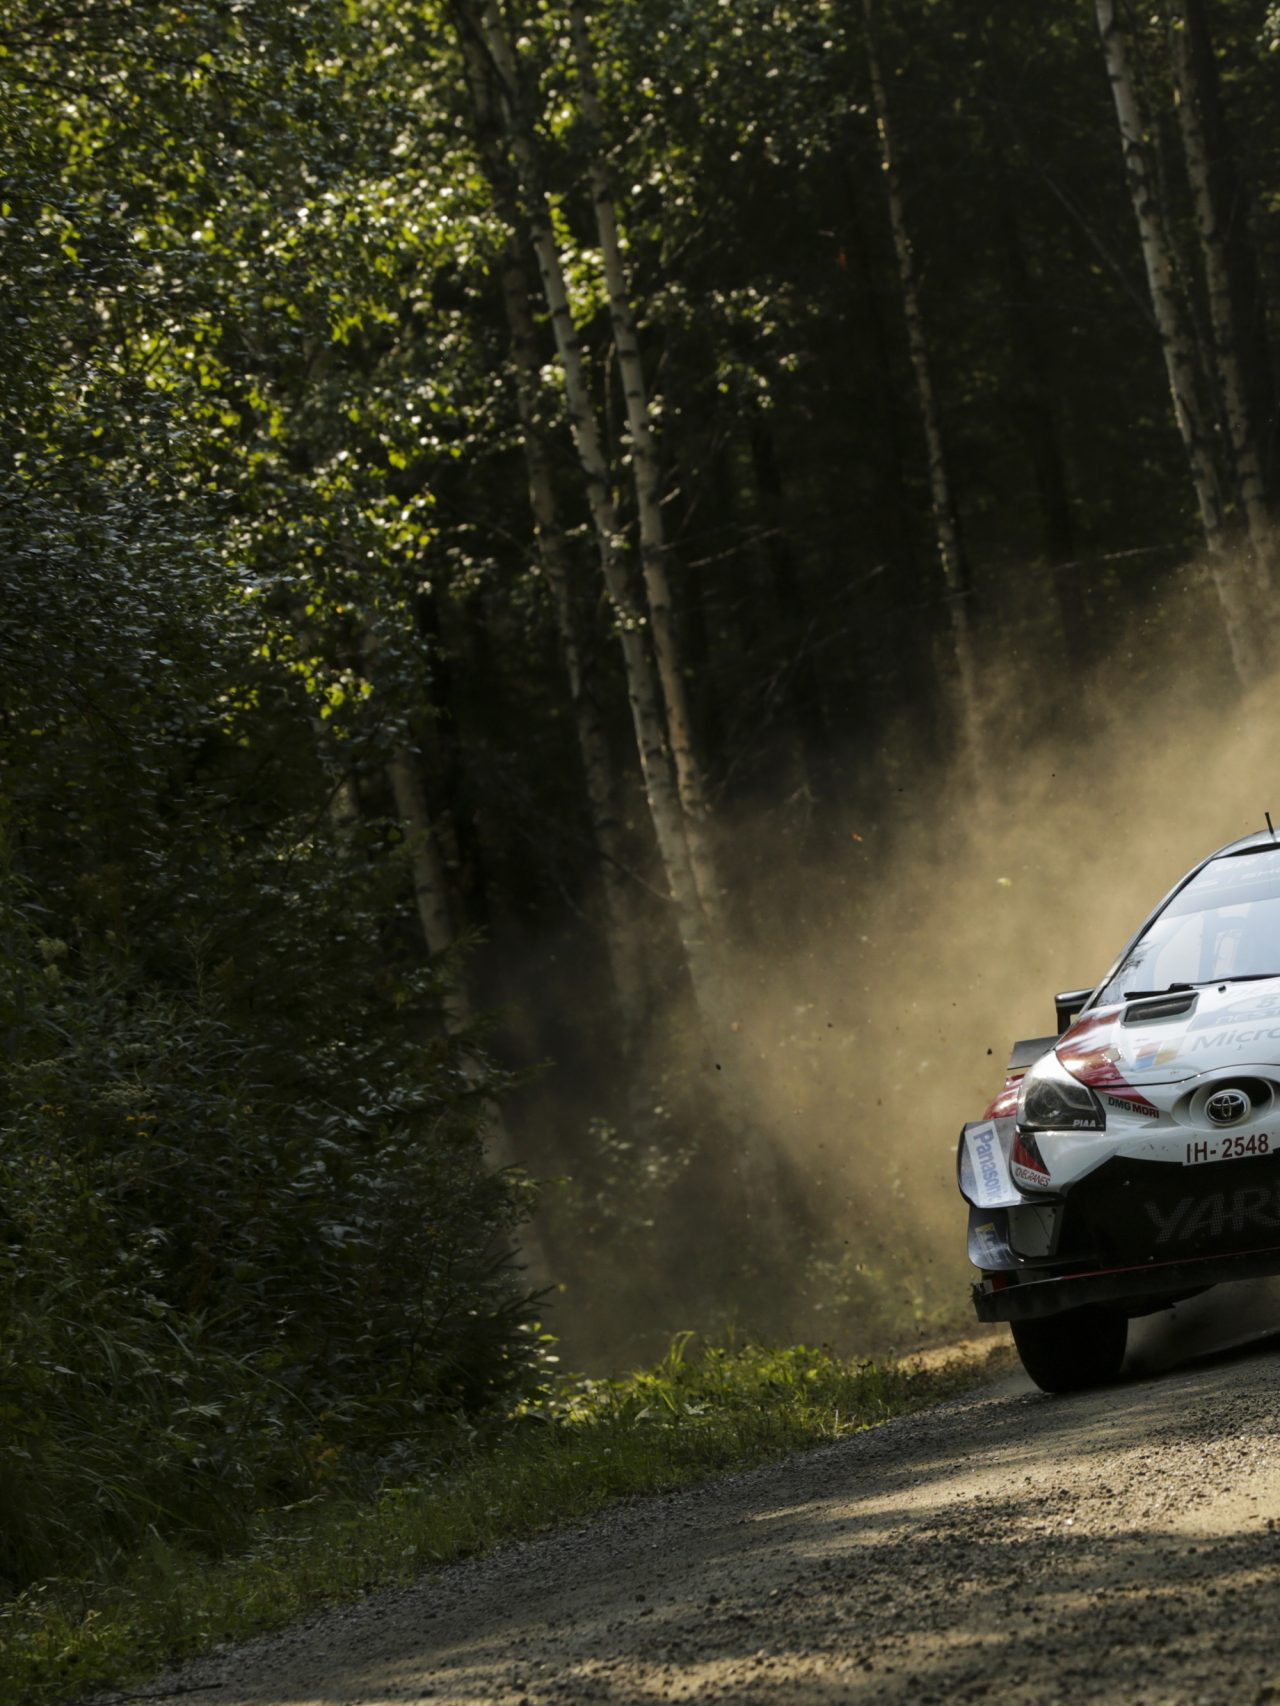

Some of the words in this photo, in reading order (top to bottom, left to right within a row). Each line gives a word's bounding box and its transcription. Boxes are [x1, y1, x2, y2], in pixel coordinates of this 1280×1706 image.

[1107, 1095, 1132, 1112] DMG
[1131, 1105, 1160, 1119] MORI
[1072, 1119, 1097, 1128] PIAA
